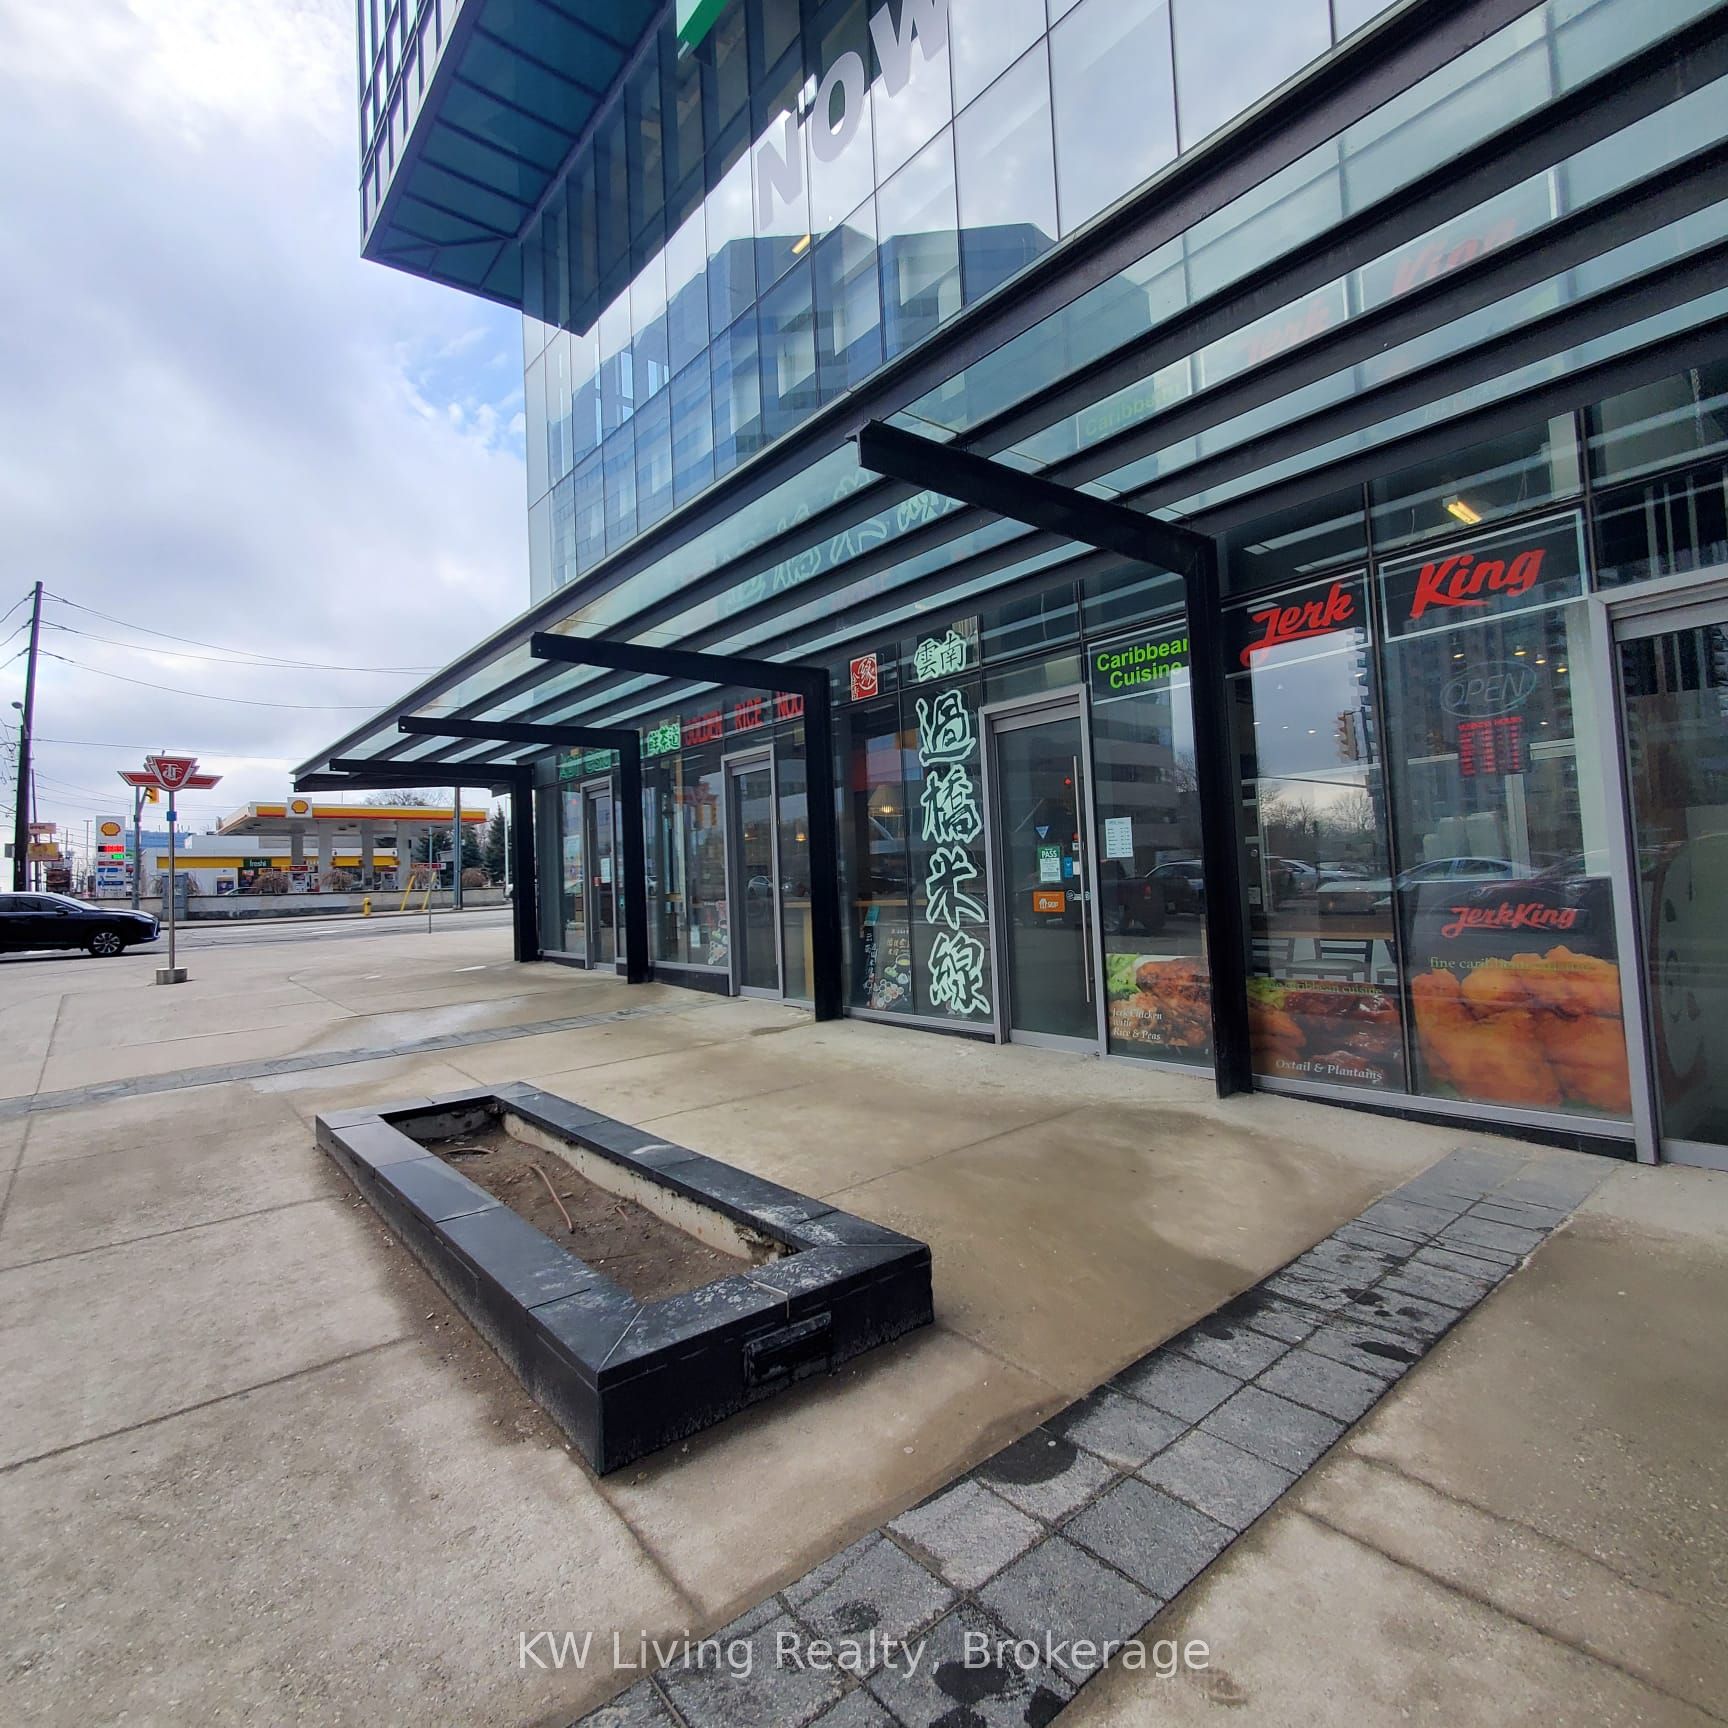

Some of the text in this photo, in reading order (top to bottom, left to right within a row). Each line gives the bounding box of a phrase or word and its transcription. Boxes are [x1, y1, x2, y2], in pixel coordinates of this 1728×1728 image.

[1240, 548, 1546, 668] Jerk King
[914, 630, 966, 681] 雲南
[1110, 661, 1182, 688] Cuisine
[1445, 671, 1525, 708] OPEN
[735, 697, 763, 730] RICE
[1041, 850, 1057, 858] PASS
[1430, 956, 1455, 969] fine
[1132, 1029, 1139, 1038] &
[1142, 1030, 1161, 1040] Peas
[1275, 1059, 1383, 1080] Oxtail & Plantains
